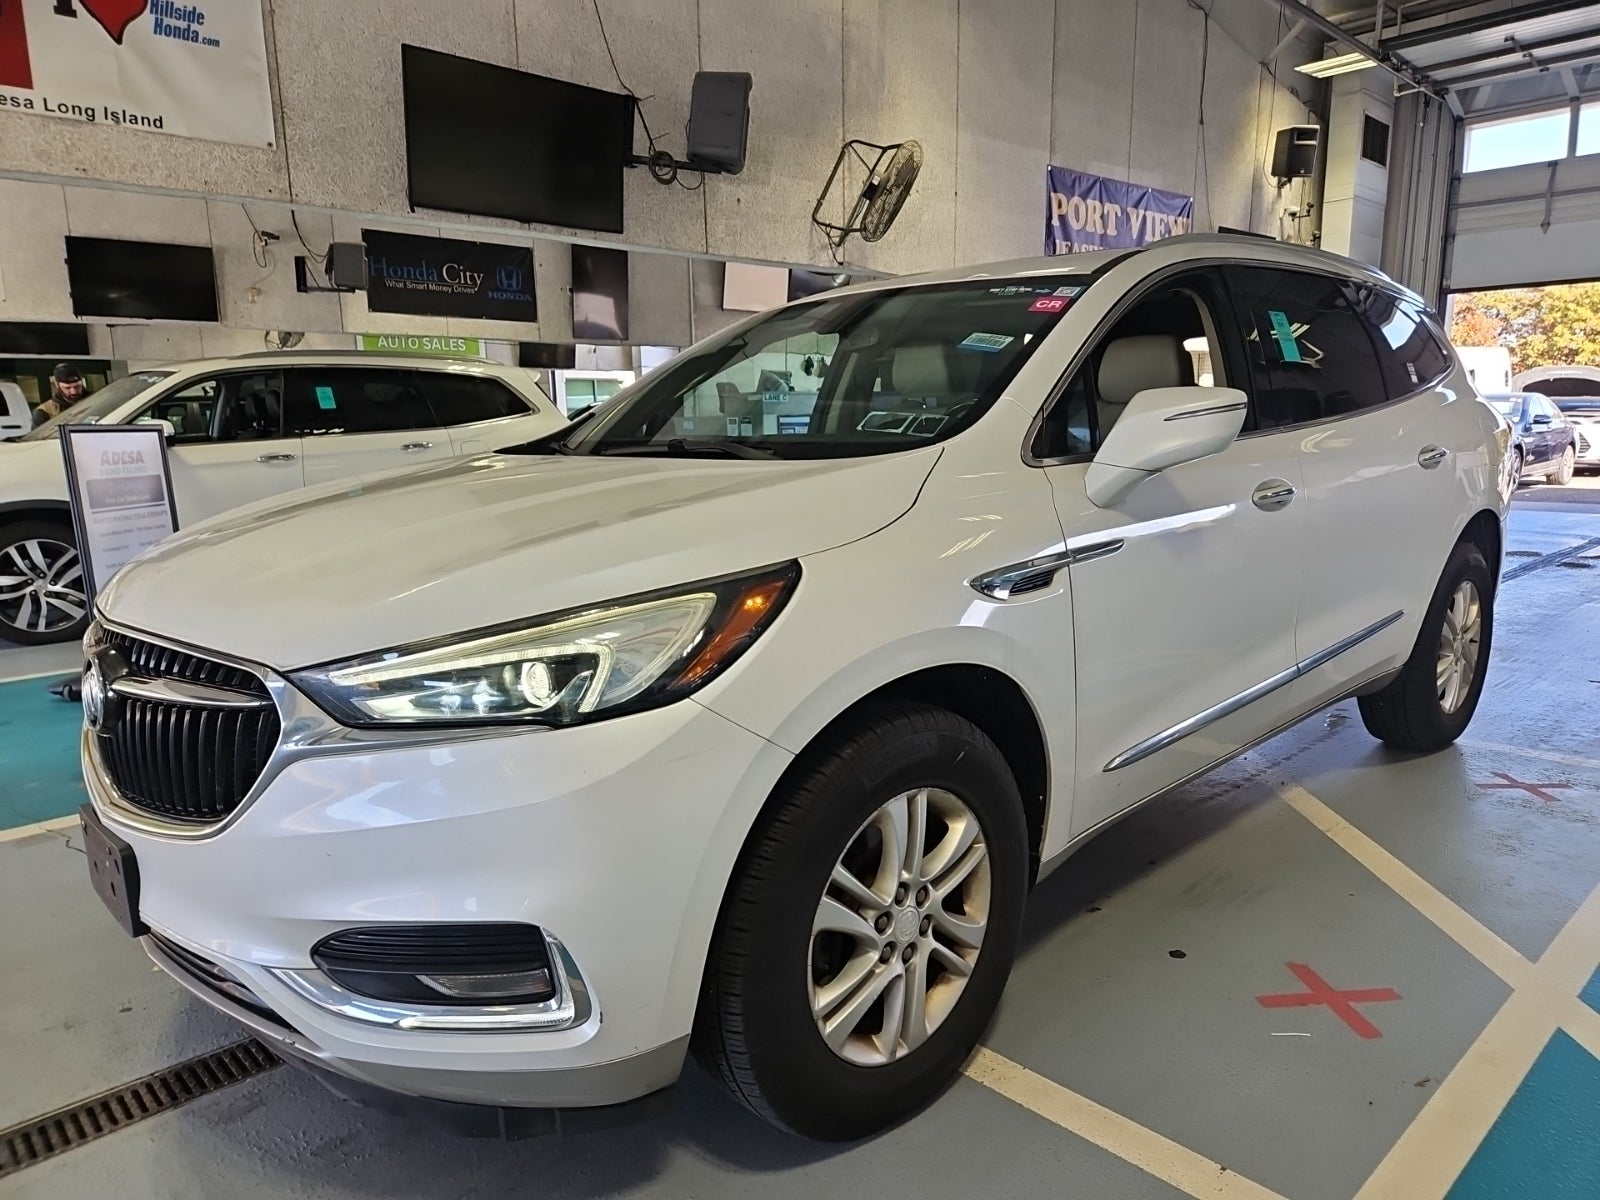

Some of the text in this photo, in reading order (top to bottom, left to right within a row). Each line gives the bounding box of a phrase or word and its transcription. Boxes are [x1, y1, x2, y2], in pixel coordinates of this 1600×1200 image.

[150, 0, 204, 25] Hillside
[43, 97, 95, 122] Long
[103, 106, 164, 129] Island
[1051, 192, 1121, 236] PORT
[369, 255, 484, 291] Honda City
[384, 279, 475, 294] What Smart Money Drives
[488, 291, 532, 301] HONDA
[1035, 300, 1062, 308] CR
[377, 335, 467, 351] AUTO SALES
